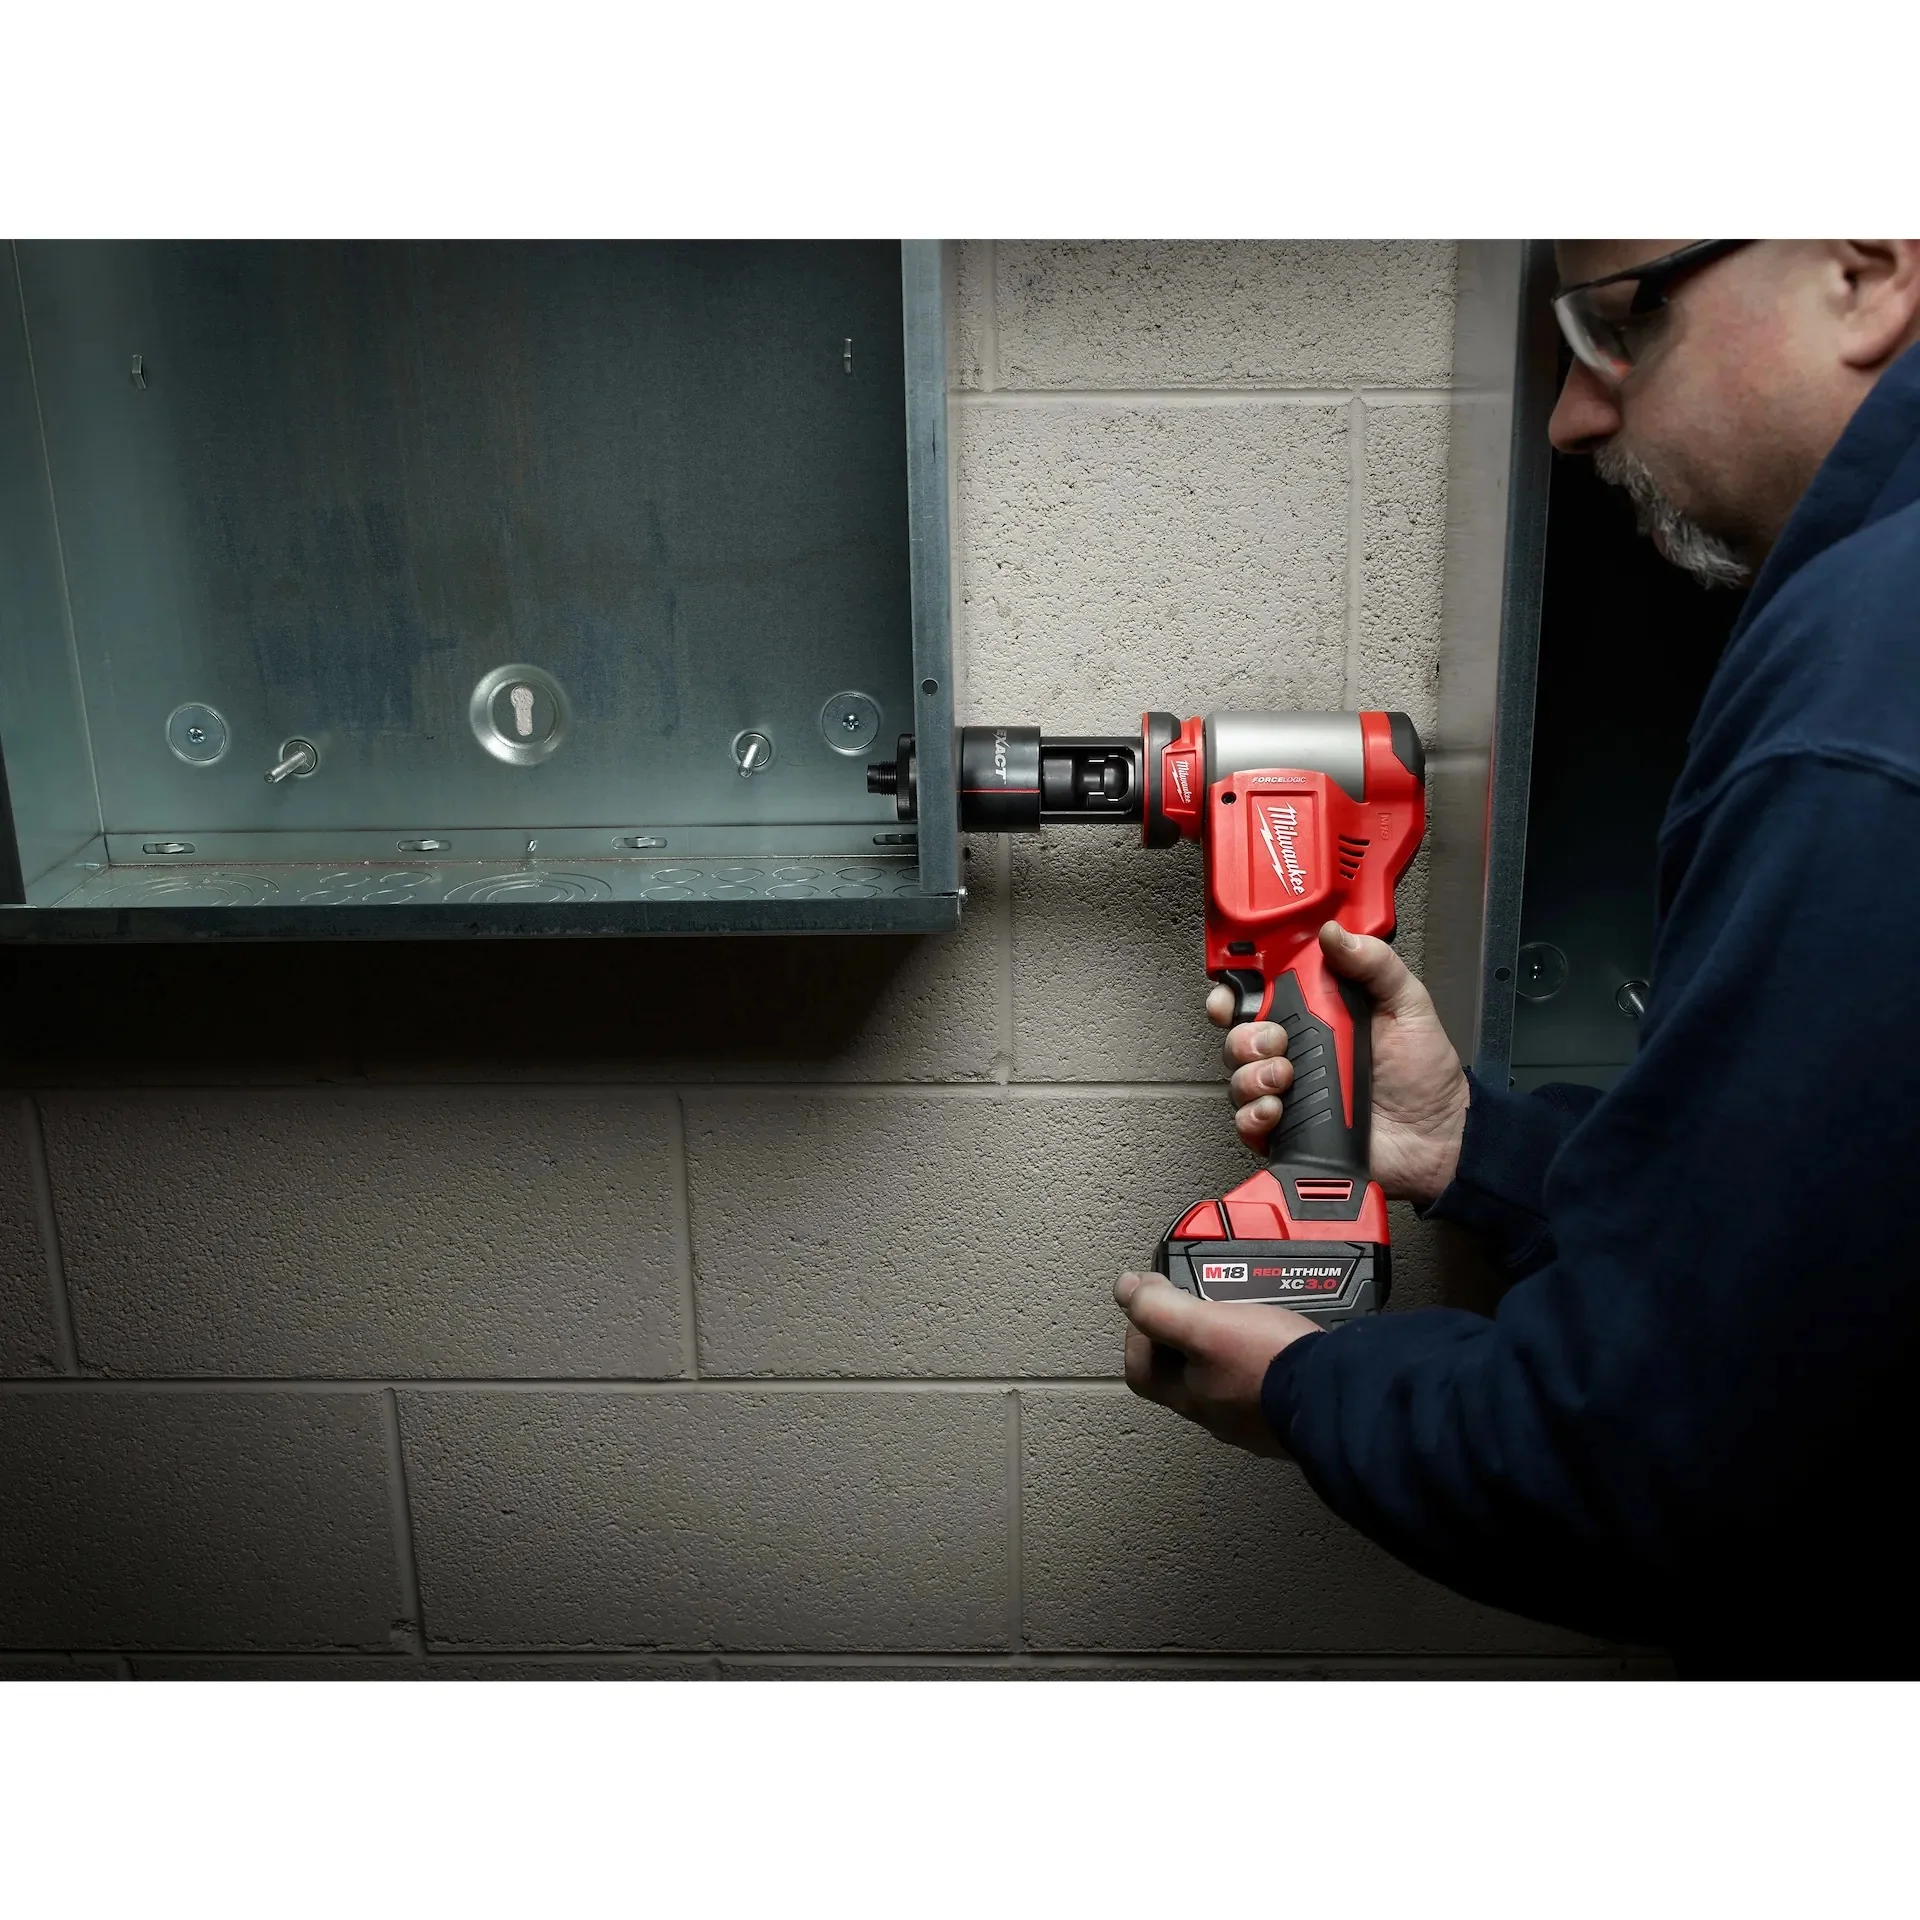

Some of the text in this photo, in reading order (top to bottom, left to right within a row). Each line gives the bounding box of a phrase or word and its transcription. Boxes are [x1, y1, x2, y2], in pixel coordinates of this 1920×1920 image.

[1176, 760, 1192, 803] Milwaukee
[1267, 802, 1307, 895] Milwaukee
[1205, 1266, 1342, 1279] M18 REDLITHIUM
[1279, 1278, 1337, 1290] XC3.0
